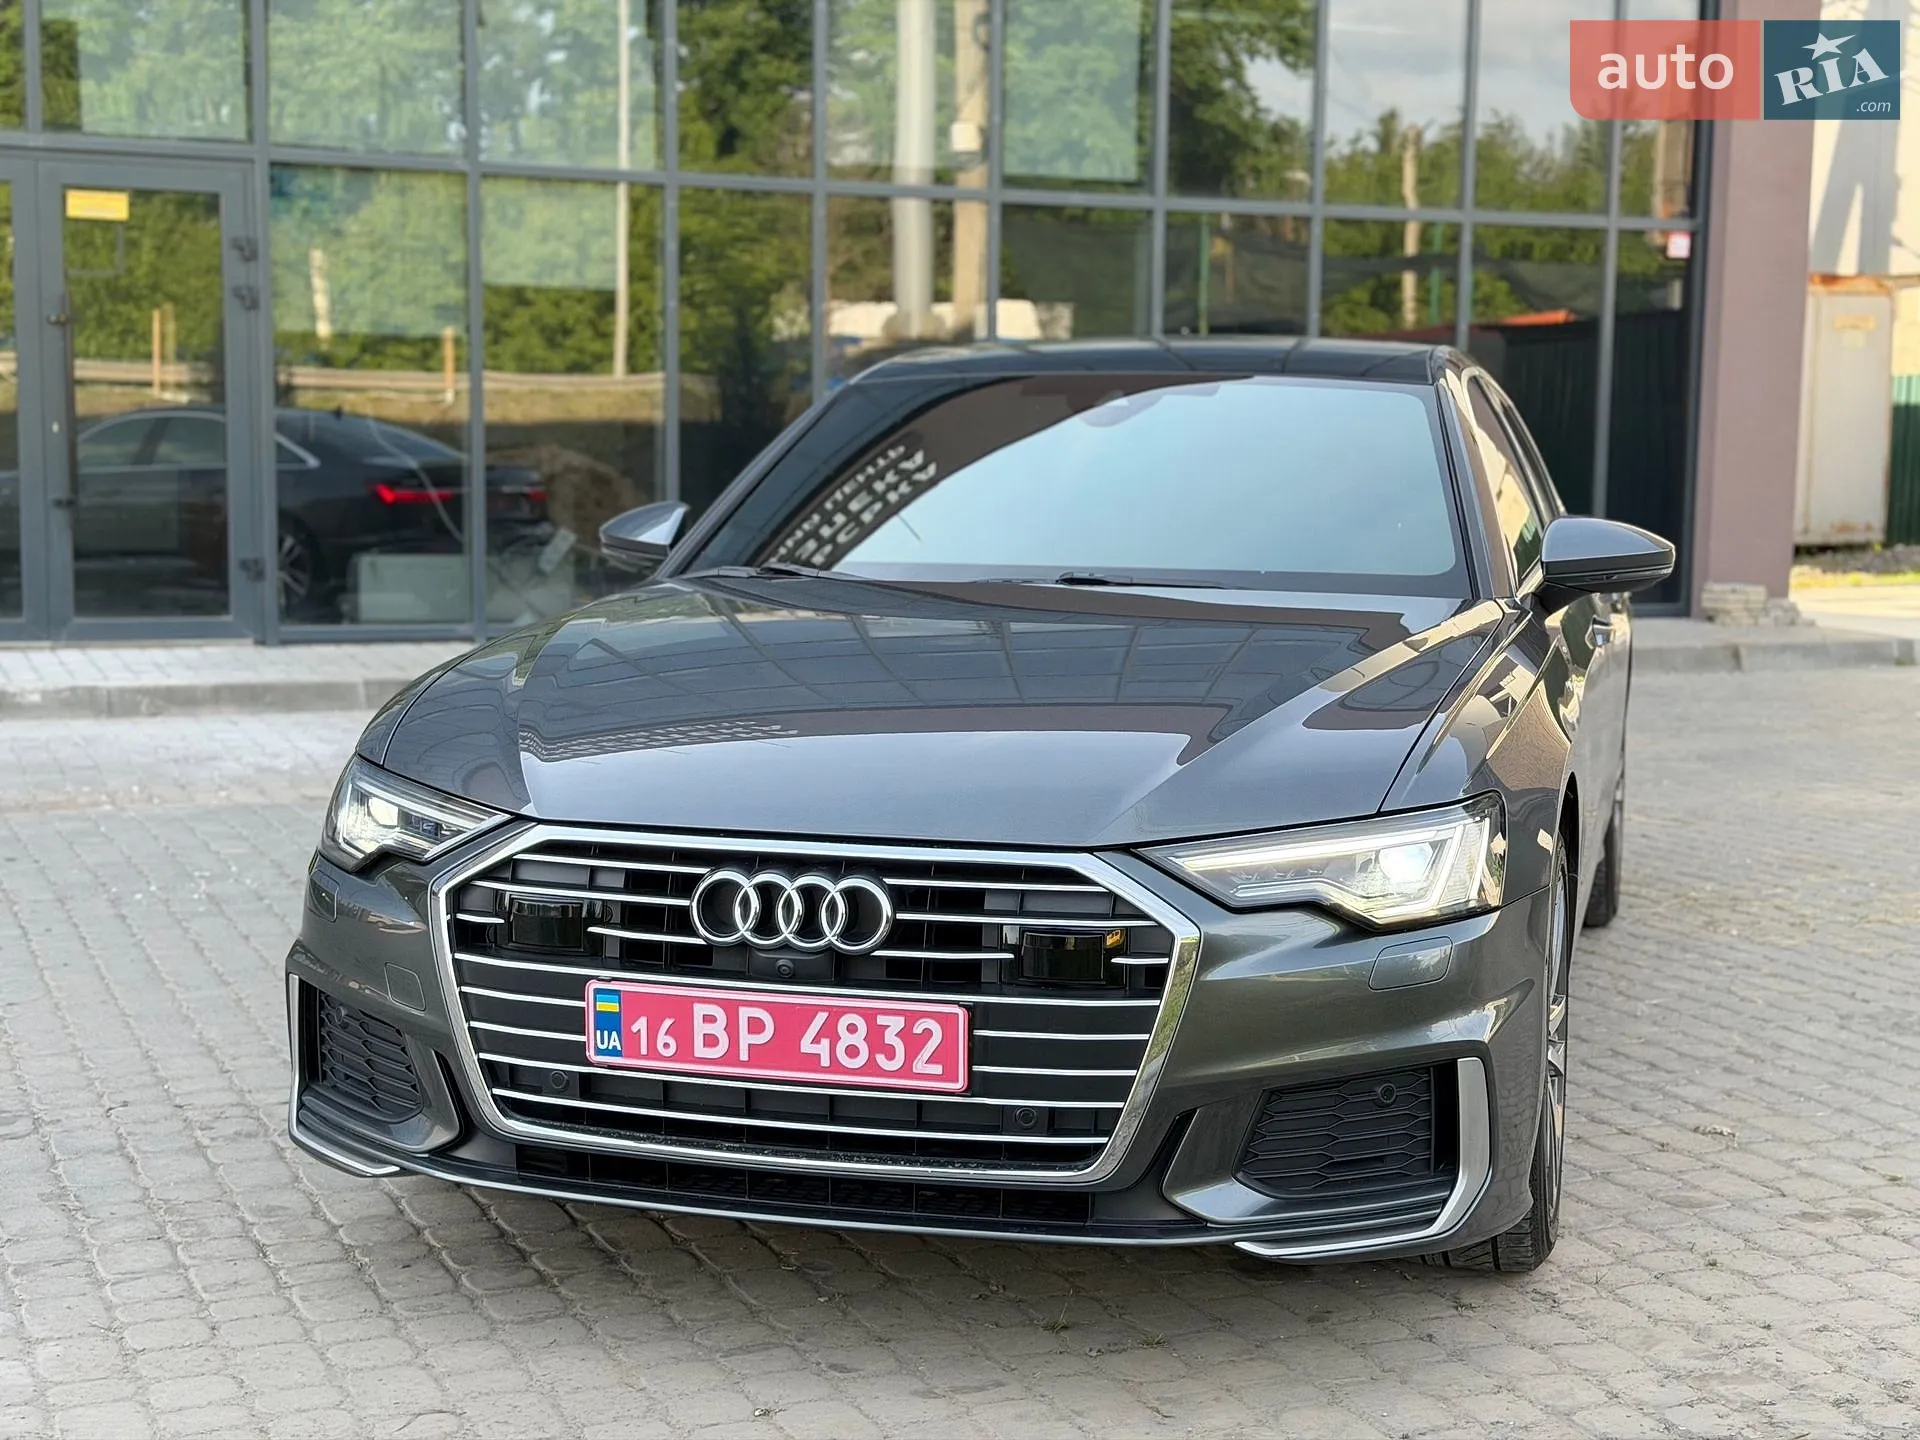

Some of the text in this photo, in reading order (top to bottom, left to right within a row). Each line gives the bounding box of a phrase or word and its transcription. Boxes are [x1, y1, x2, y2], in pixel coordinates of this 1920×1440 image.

[596, 1030, 621, 1051] UA
[630, 1002, 943, 1075] 16 BP 4832
